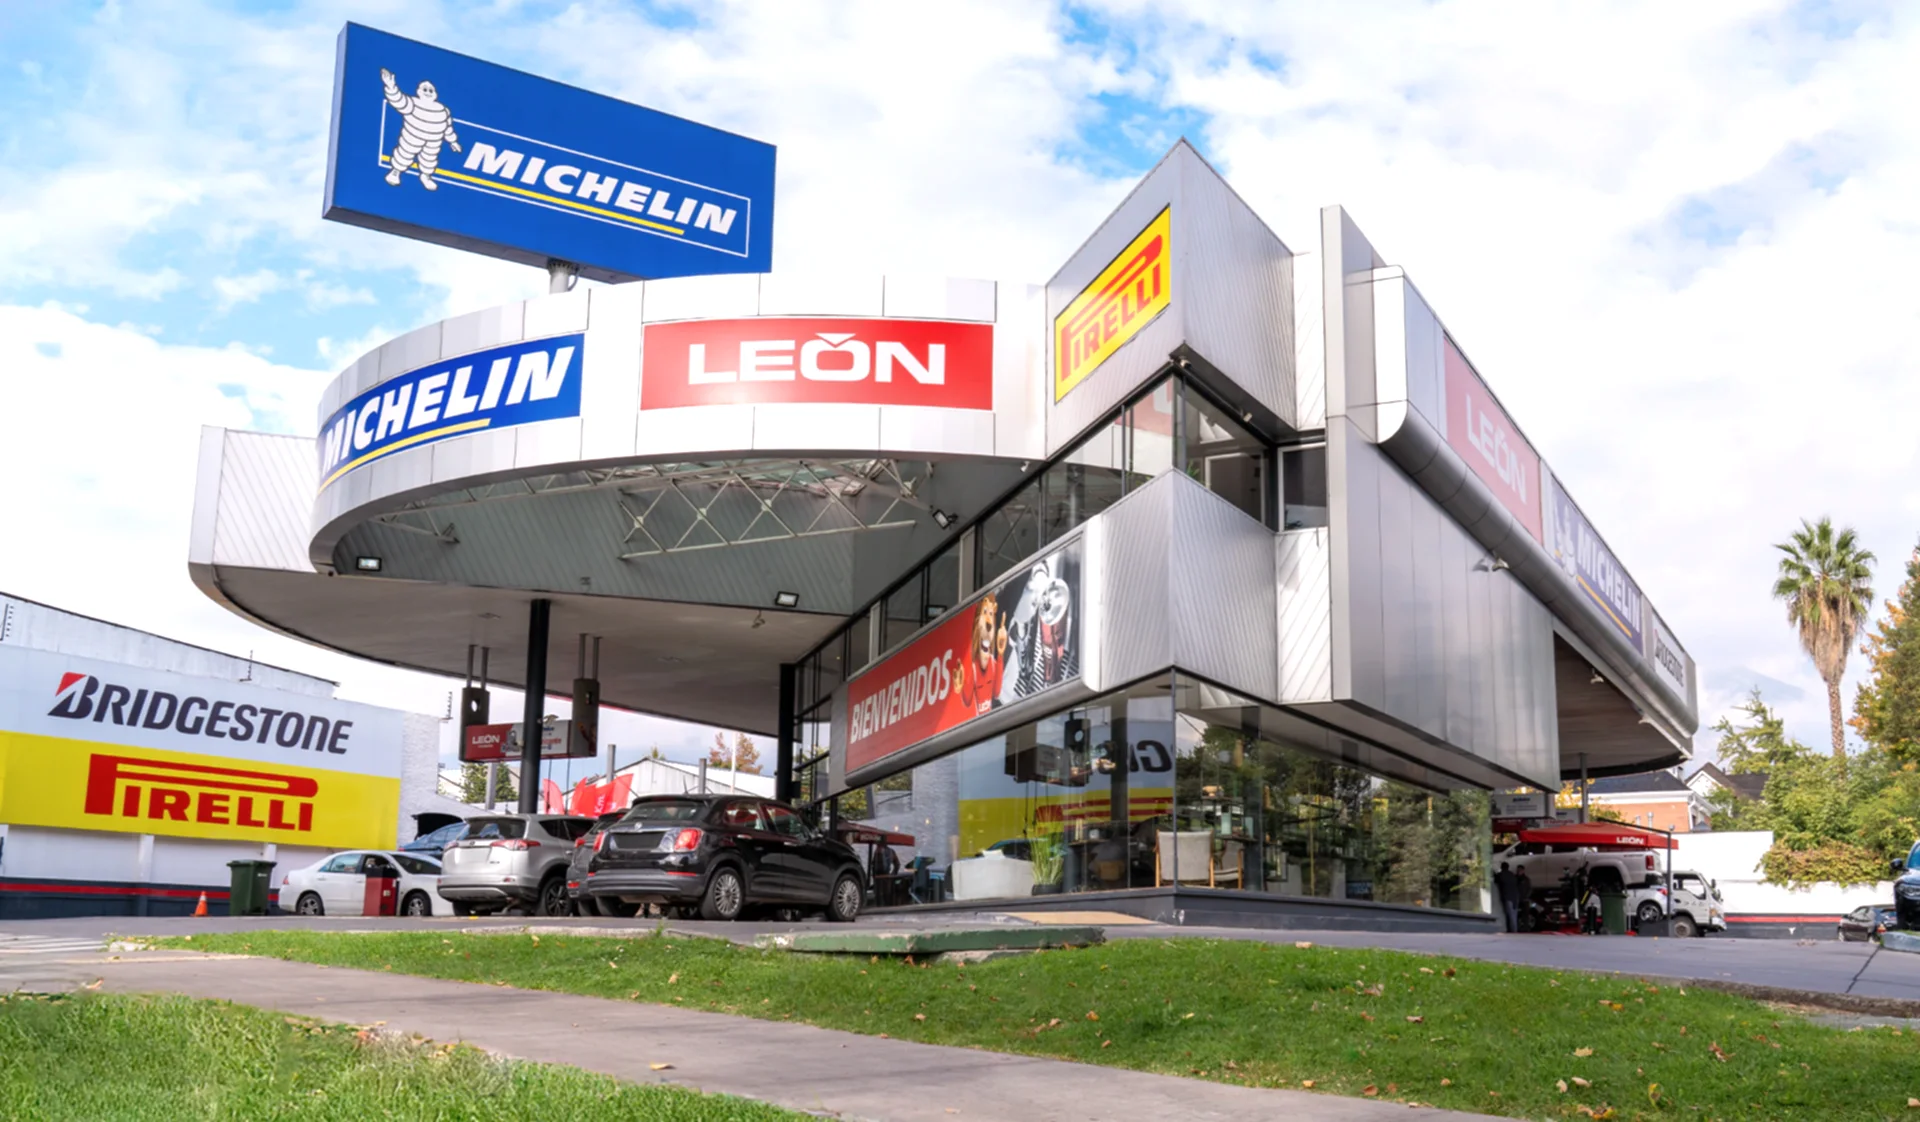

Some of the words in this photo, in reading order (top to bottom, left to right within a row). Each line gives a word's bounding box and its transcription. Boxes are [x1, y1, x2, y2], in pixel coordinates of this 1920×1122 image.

[463, 142, 737, 235] MICHELIN
[1061, 234, 1163, 382] PIRELLI
[321, 346, 575, 478] MICHELIN
[1577, 522, 1640, 634] MICHELIN
[47, 672, 353, 755] BRIDGESTONE
[850, 649, 953, 744] BIENVENIDOS
[84, 753, 319, 831] PIRELLI
